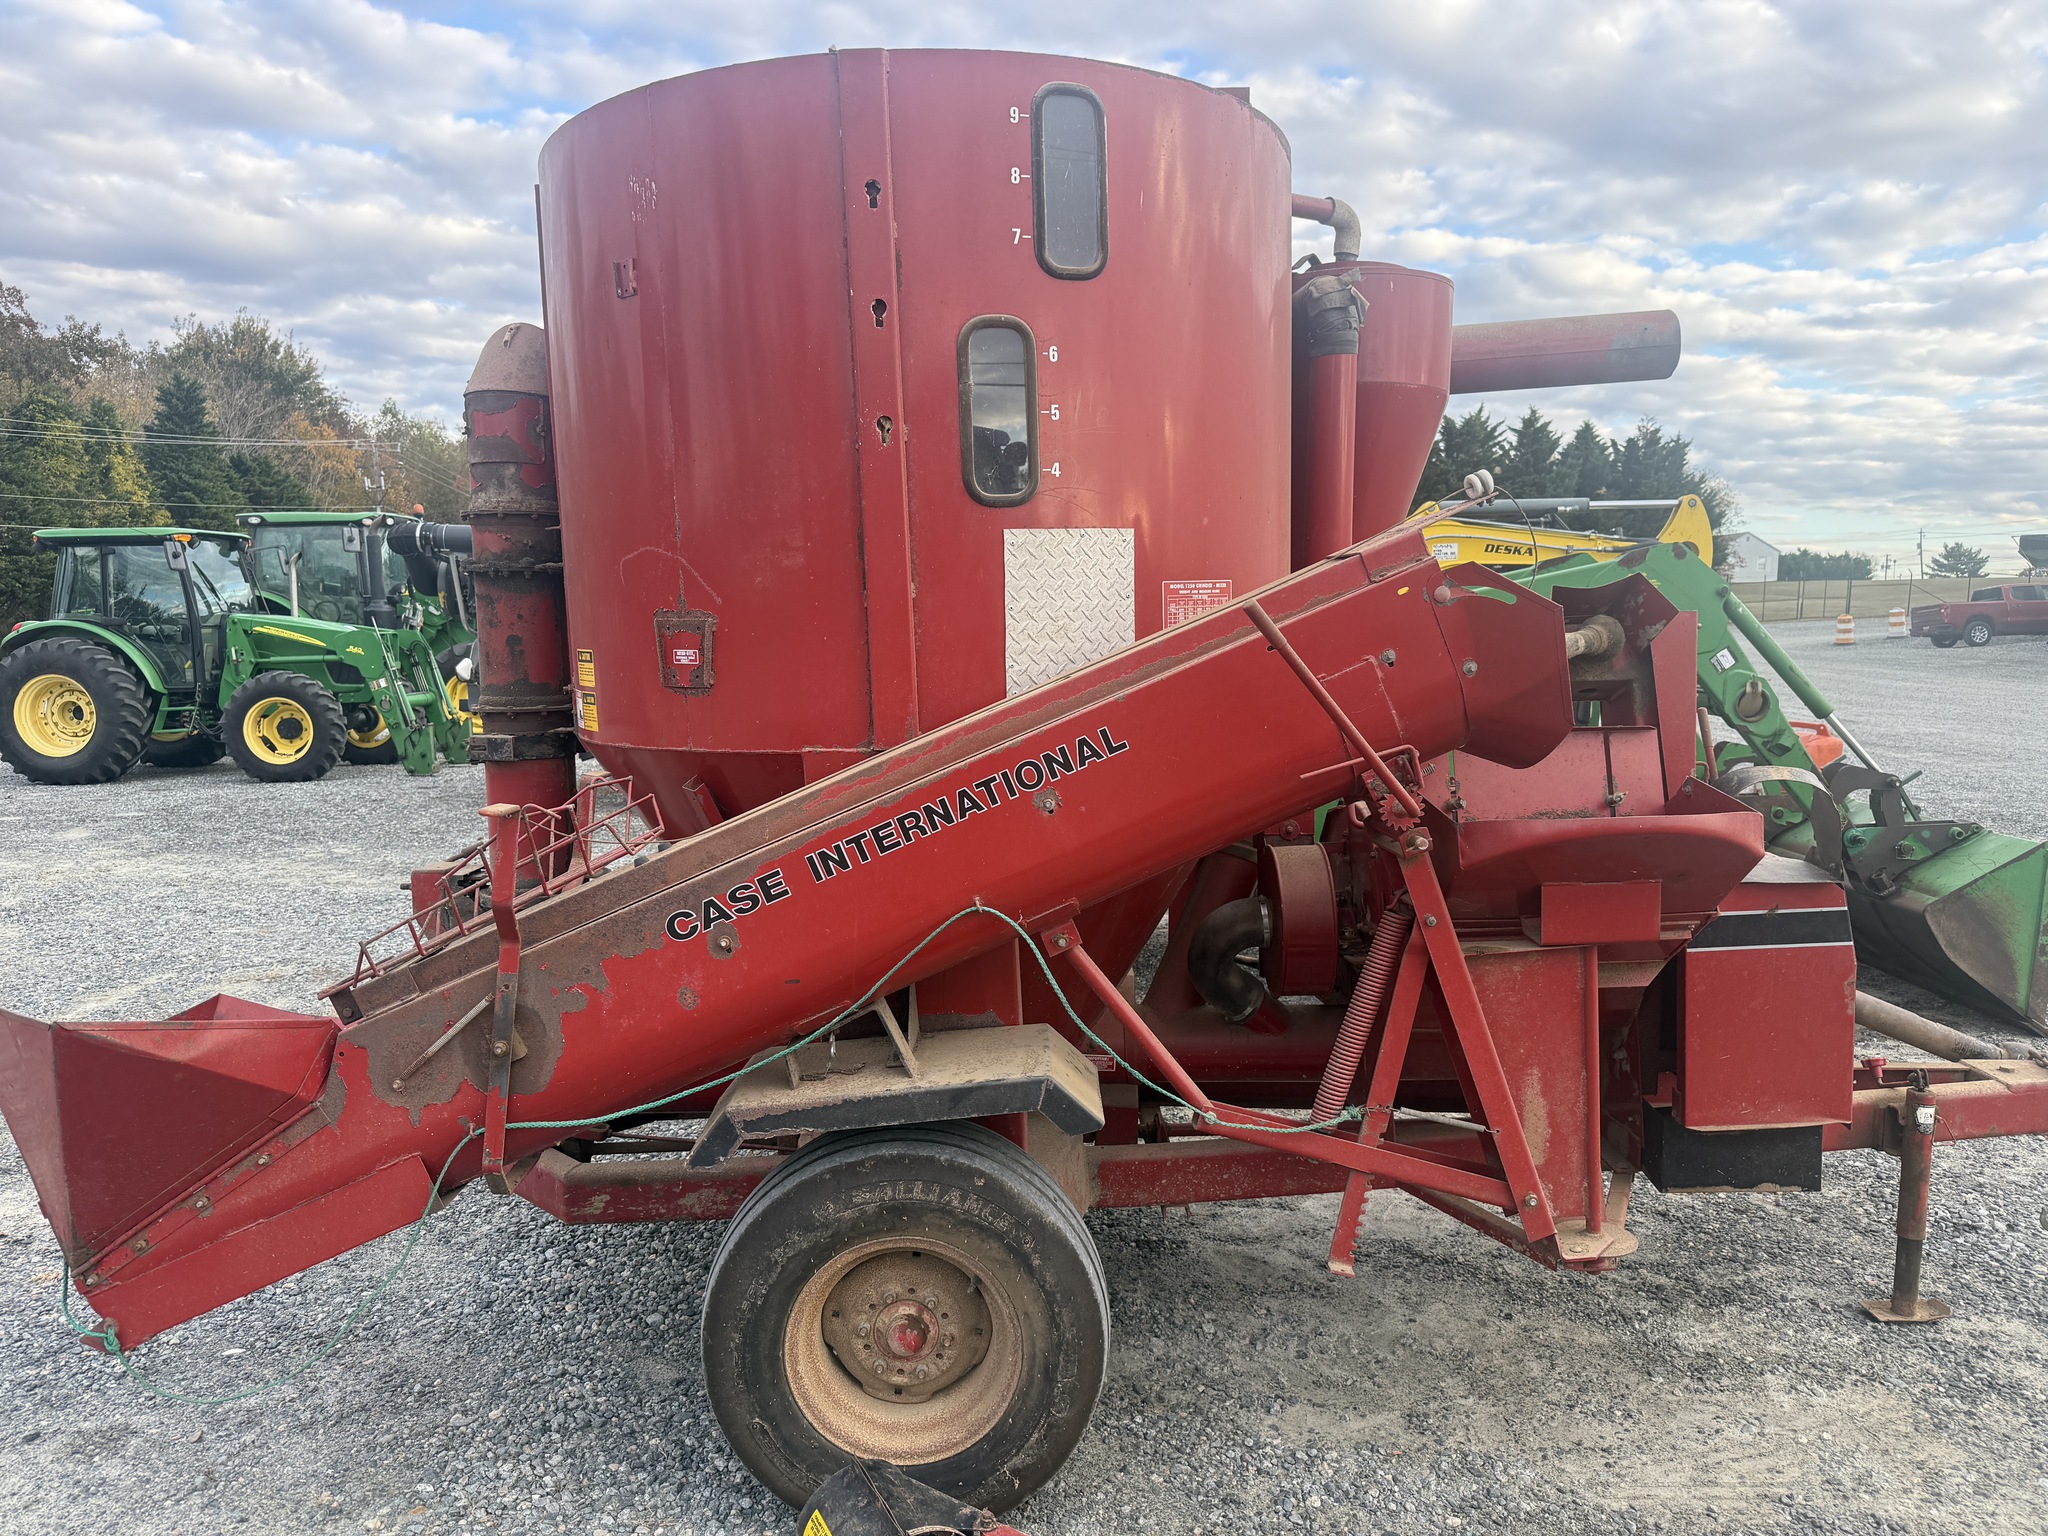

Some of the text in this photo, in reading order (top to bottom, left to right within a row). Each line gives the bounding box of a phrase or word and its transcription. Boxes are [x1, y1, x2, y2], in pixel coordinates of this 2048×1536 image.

[1009, 106, 1020, 124] 9
[1010, 167, 1021, 184] 8
[1011, 228, 1021, 245] 7
[1048, 345, 1059, 363] 6
[1050, 404, 1060, 421] 5
[1050, 462, 1062, 478] 4
[1483, 543, 1534, 557] DESKA
[664, 725, 1129, 942] CASE INTERNATIONAL
